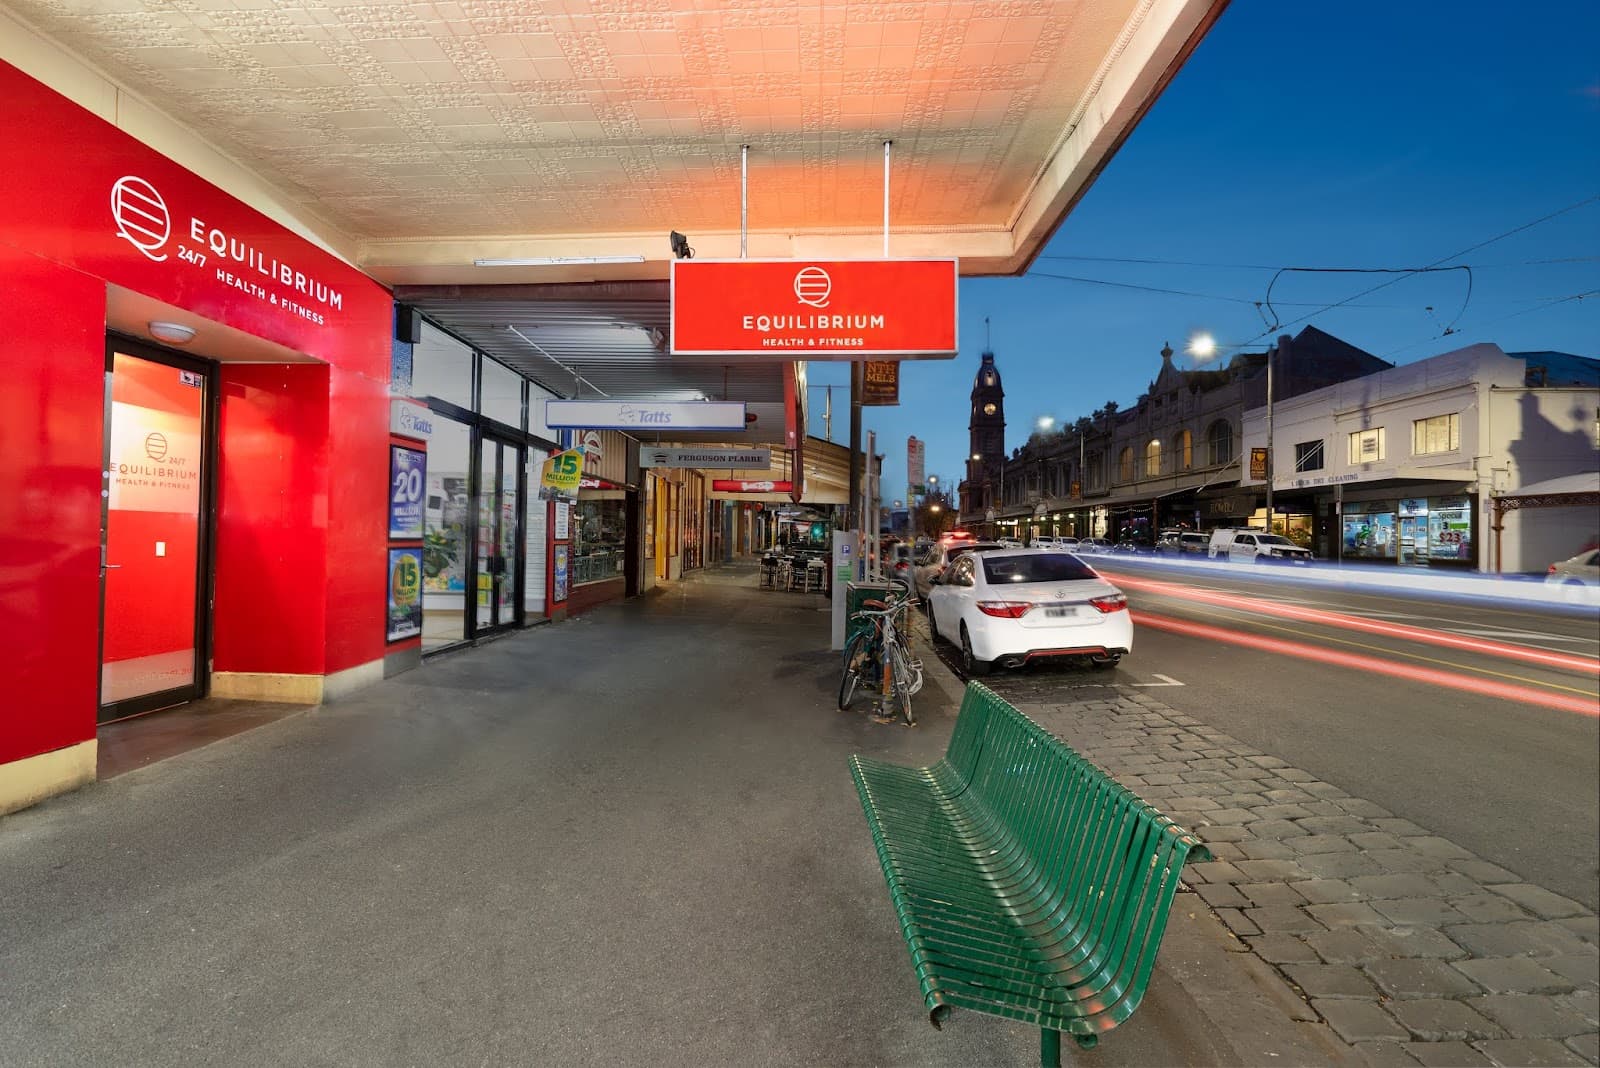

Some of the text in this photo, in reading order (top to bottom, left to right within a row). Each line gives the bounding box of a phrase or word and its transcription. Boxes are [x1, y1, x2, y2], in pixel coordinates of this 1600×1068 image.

[177, 245, 206, 268] 24/7
[190, 217, 343, 311] EQUILIBRIUM
[216, 268, 324, 326] HEALTH & FITNESS
[743, 314, 884, 332] EQUILIBRIUM
[762, 337, 864, 347] HEALTH & FITNESS
[412, 415, 432, 434] Tatts
[638, 409, 671, 424] Tatts
[552, 455, 577, 475] 15
[678, 454, 725, 463] FERGUSON
[110, 462, 197, 480] EQUILIBRIUM
[116, 478, 148, 487] HEALTH
[159, 480, 190, 490] FITNESS
[393, 468, 421, 503] 20
